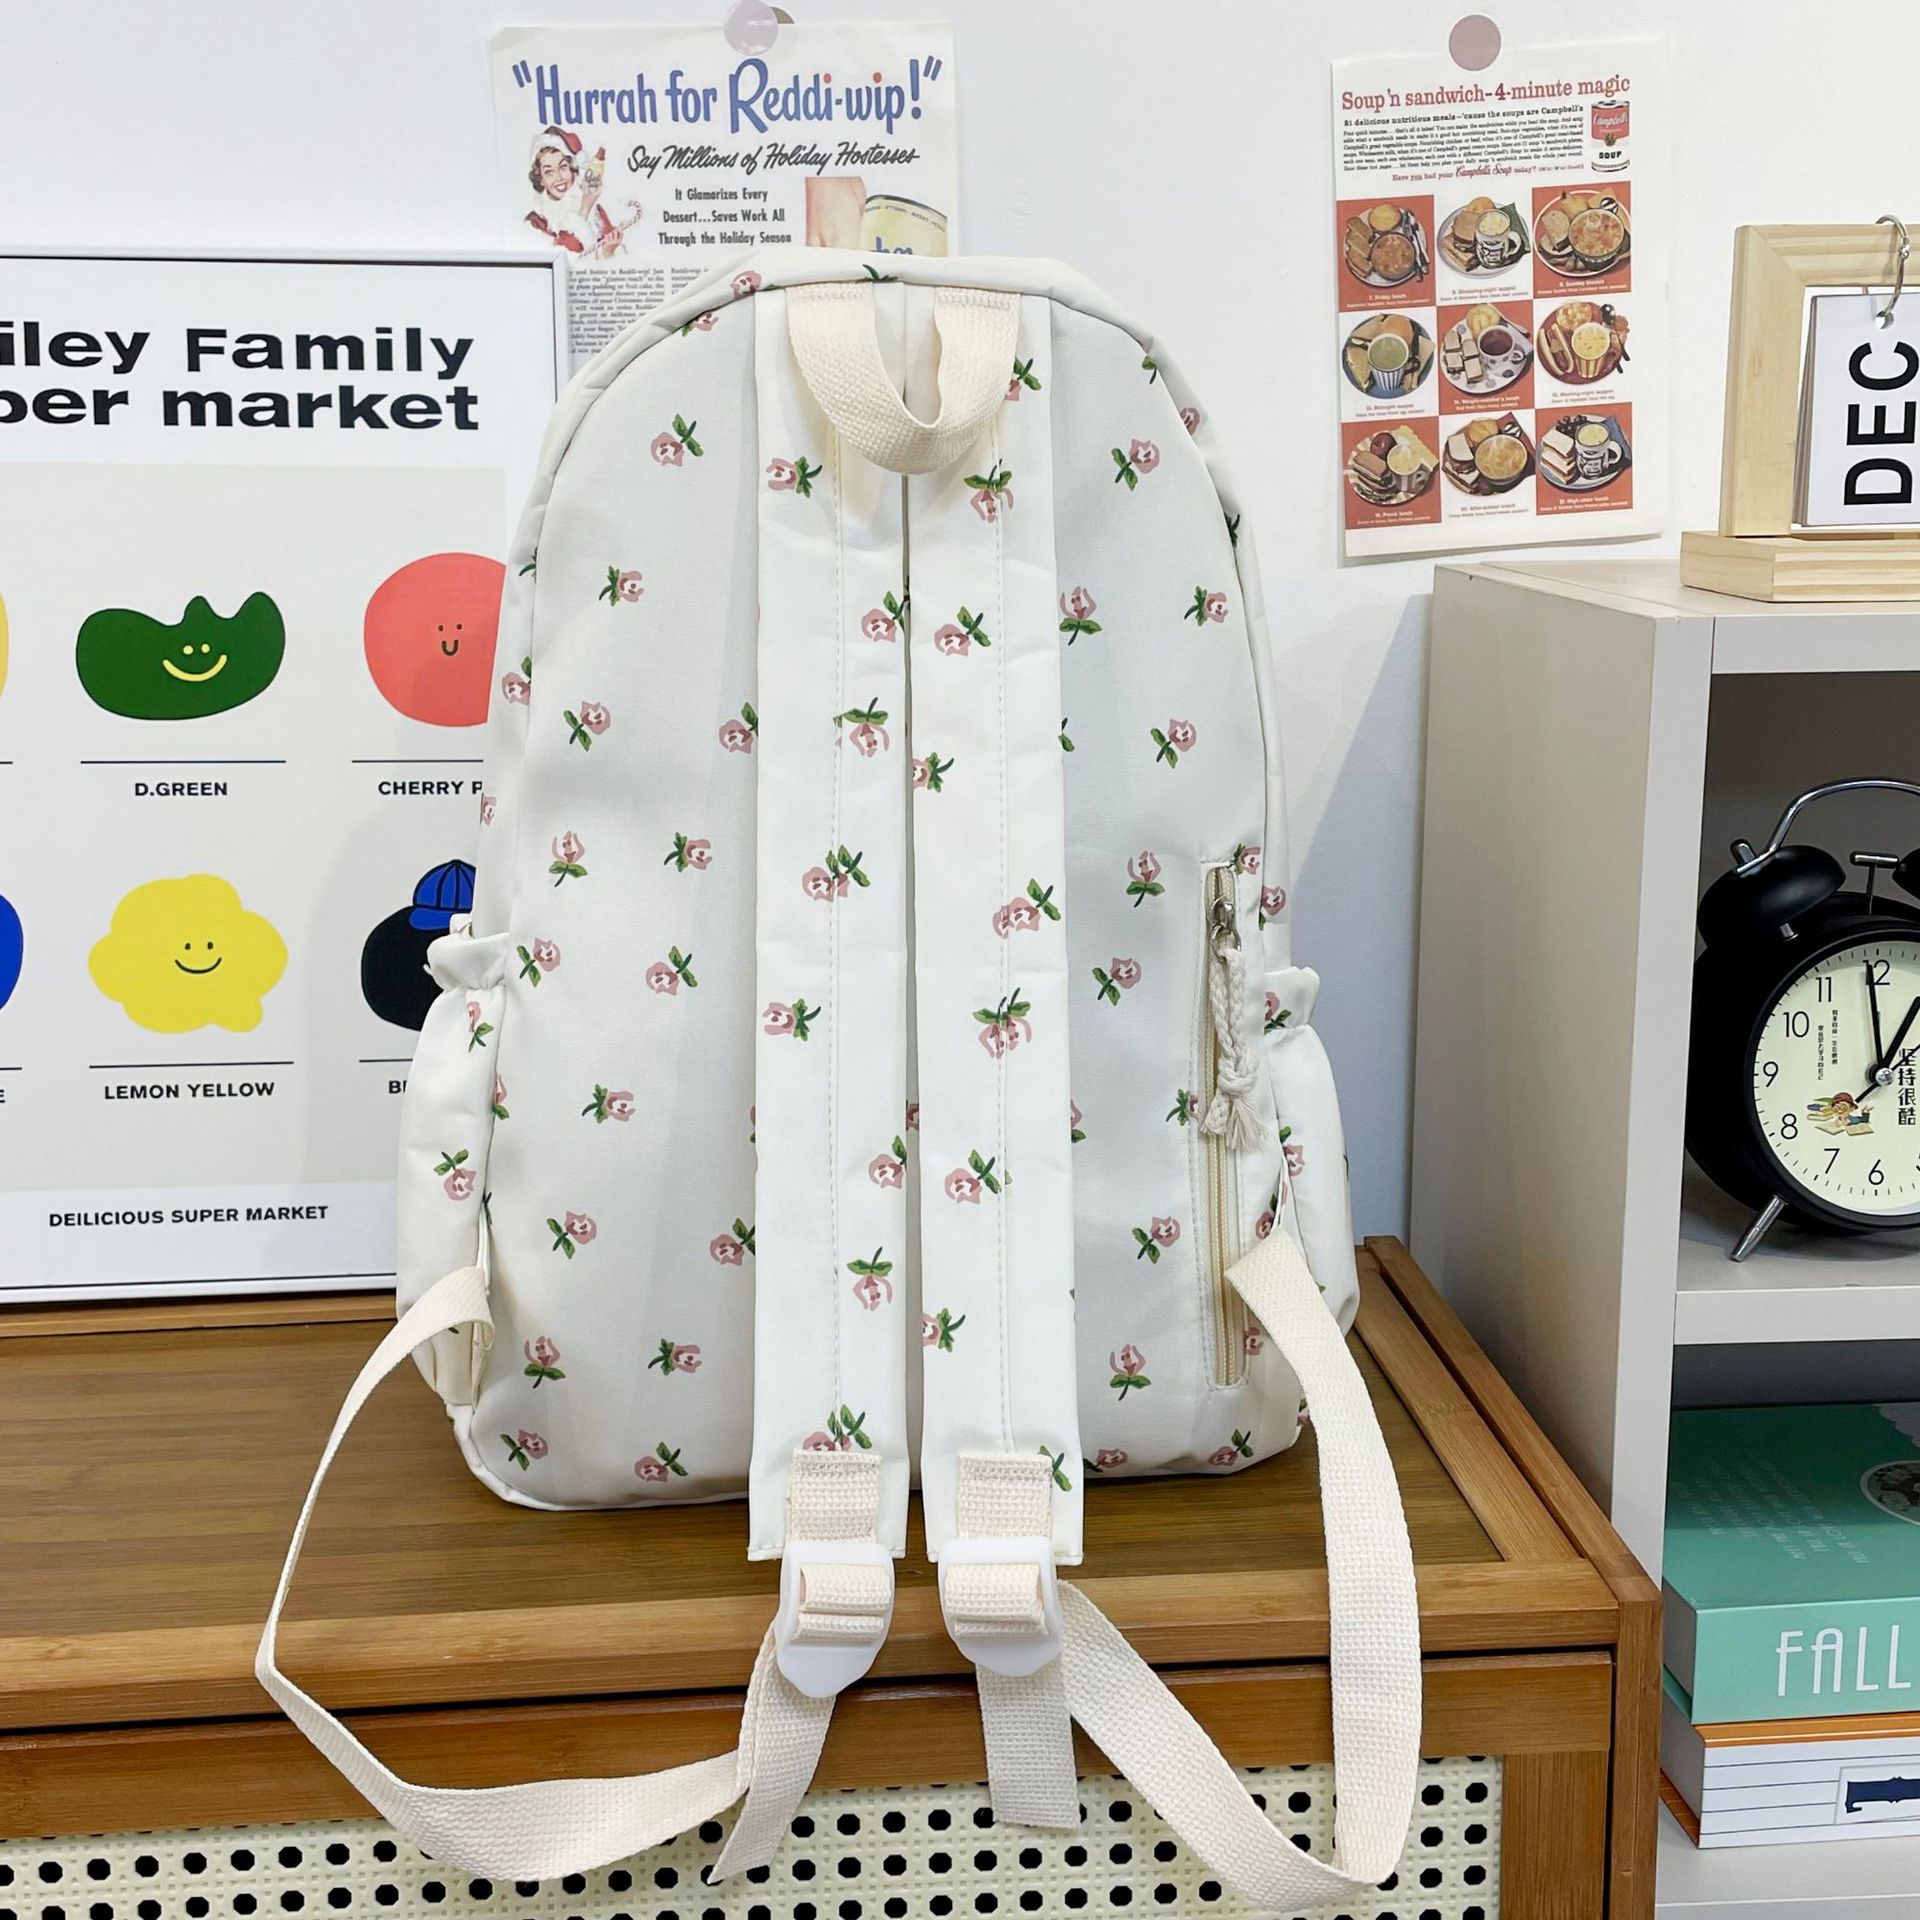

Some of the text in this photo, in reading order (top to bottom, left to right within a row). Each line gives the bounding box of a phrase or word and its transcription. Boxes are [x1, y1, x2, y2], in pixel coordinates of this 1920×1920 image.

[665, 70, 718, 123] for
[1577, 74, 1631, 98] magic
[1354, 117, 1389, 126] delicious
[1391, 115, 1430, 124] nutritious
[1487, 110, 1500, 118] the
[1540, 105, 1583, 116] Campbell's
[628, 145, 661, 179] Say
[663, 144, 739, 169] Millions
[740, 146, 763, 176] of
[762, 142, 833, 176] Holiday
[834, 141, 920, 166] Hostesses
[1599, 150, 1621, 159] SOUP
[675, 188, 682, 200] It
[742, 187, 768, 202] Every
[741, 208, 767, 221] Work
[772, 208, 785, 221] All
[658, 230, 792, 247] Through the Holiday Season
[187, 328, 474, 380] Family
[163, 385, 479, 430] market
[1843, 340, 1920, 506] DEC
[134, 781, 229, 797] D.GREEN
[378, 780, 465, 795] CHERRY
[1815, 976, 1832, 1003] 11
[1783, 1011, 1810, 1038] 10
[1762, 1061, 1779, 1088] 9
[104, 1081, 275, 1099] LEMON YELLOW
[1781, 1113, 1799, 1140] 8
[1824, 1148, 1840, 1174] 7
[1868, 1159, 1885, 1186] 6
[49, 1205, 329, 1227] DEILICIOUS SUPER MARKET
[1775, 1624, 1911, 1697] FALL
